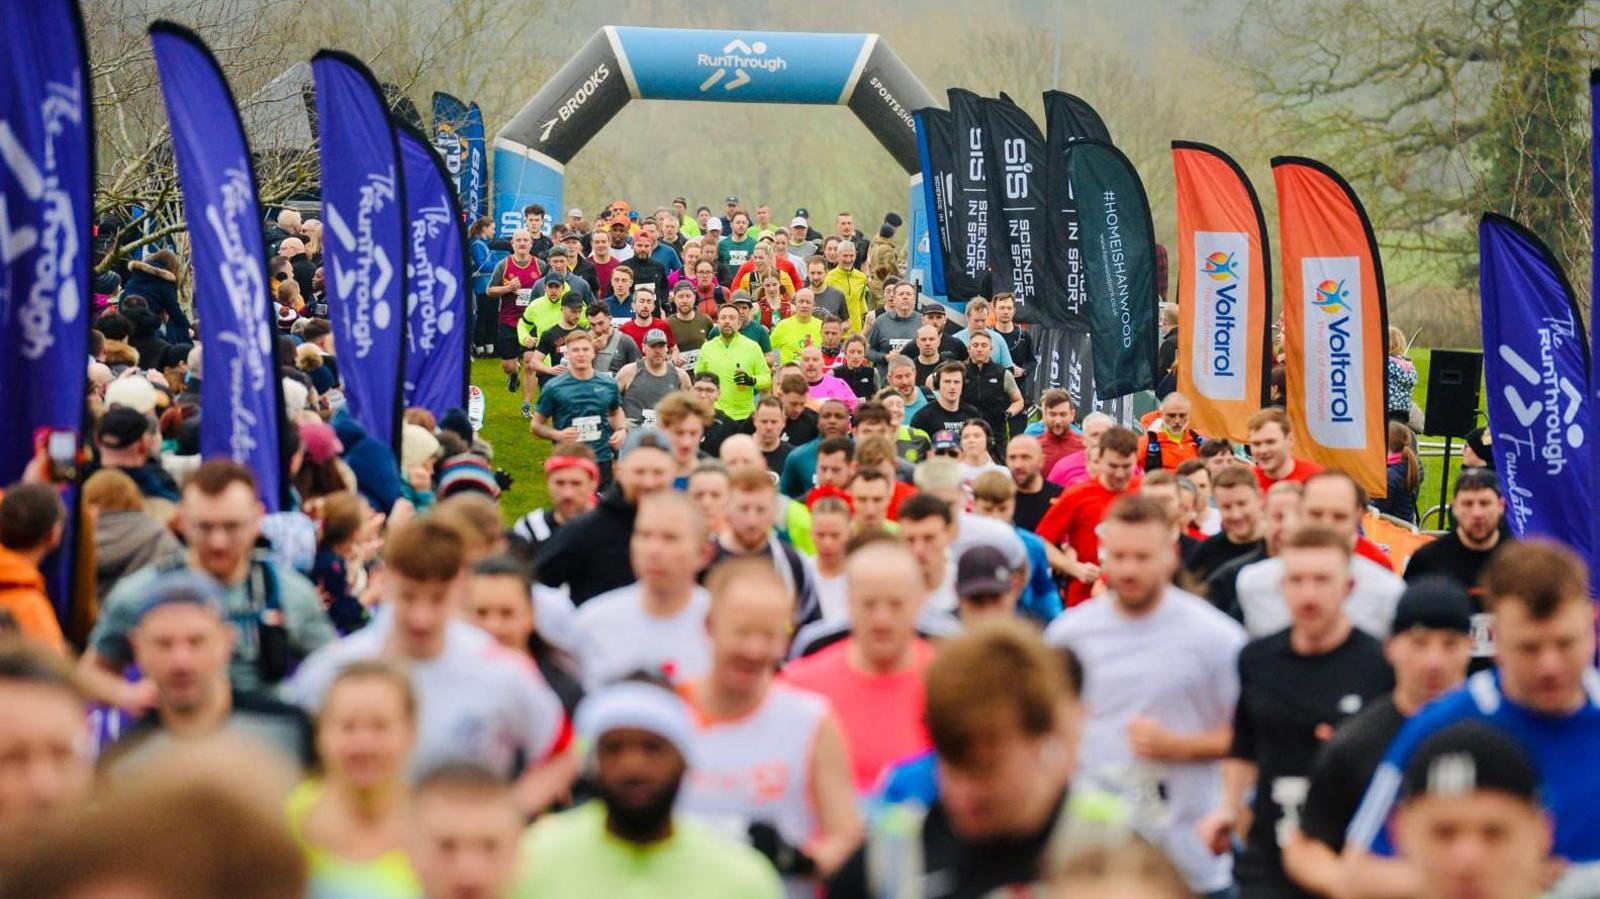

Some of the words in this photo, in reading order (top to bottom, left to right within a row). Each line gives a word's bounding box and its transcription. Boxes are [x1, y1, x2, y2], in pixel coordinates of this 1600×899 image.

[557, 62, 611, 123] BROOKS
[697, 53, 788, 73] RunThrough
[367, 164, 395, 214] The
[1004, 137, 1034, 199] SiS
[418, 195, 452, 238] The
[967, 200, 977, 220] IN
[978, 200, 989, 271] SCIENCE
[1008, 219, 1019, 237] IN
[1067, 222, 1079, 241] IN
[352, 185, 375, 359] RunThrough
[966, 223, 977, 279] SPORT
[1011, 243, 1025, 307] SPORT
[1019, 218, 1035, 297] SCIENCE
[1067, 246, 1079, 315] SPORT
[1103, 189, 1132, 349] #HOMEISHANWOOD
[1213, 283, 1237, 377] Voltarol
[1542, 308, 1575, 349] The
[1328, 316, 1354, 422] Voltarol
[1537, 327, 1568, 475] RunThrough
